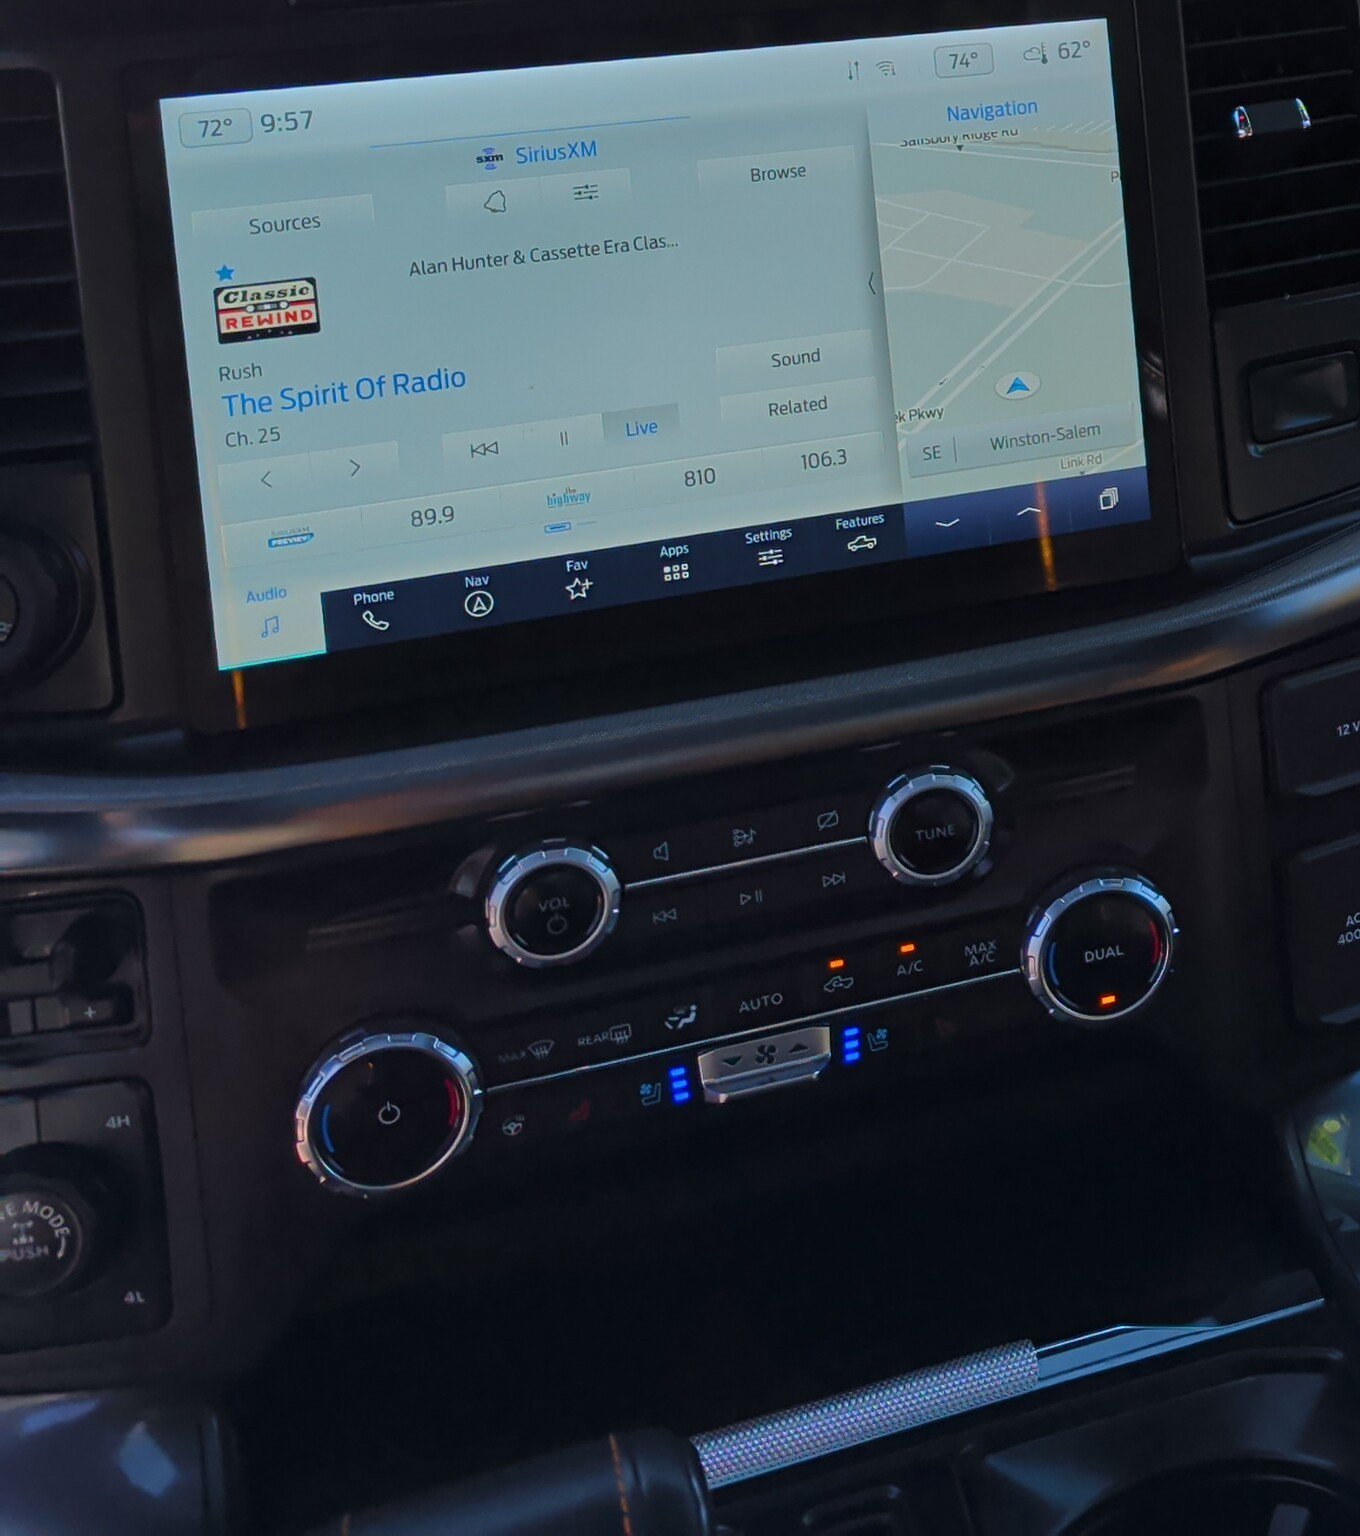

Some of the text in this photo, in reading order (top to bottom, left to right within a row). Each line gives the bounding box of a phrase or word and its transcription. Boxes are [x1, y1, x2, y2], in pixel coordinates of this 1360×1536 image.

[1058, 40, 1091, 60] 62°
[949, 51, 978, 69] 74°
[946, 100, 1039, 122] Navigation
[198, 118, 233, 138] 72°
[260, 110, 313, 133] 9:57
[475, 153, 504, 164] sxm
[515, 139, 598, 165] SiriusXM
[750, 164, 807, 183] Browse
[249, 215, 321, 235] Sources
[409, 235, 679, 276] Alan Hunter & Cassette Era Clas...
[223, 284, 310, 304] Classic
[225, 309, 314, 330] REWIND
[771, 348, 821, 368] Sound
[218, 362, 263, 382] Rush
[221, 367, 467, 417] The Spirit Of Radio
[768, 396, 828, 417] Related
[908, 406, 945, 422] Pkwy
[225, 426, 281, 448] Ch. 25
[626, 420, 658, 437] Live
[989, 423, 1101, 452] Winston-Salem
[800, 448, 848, 470] 106.3
[922, 445, 942, 461] SE
[1059, 453, 1103, 470] Link Rd
[684, 467, 717, 487] 810
[546, 491, 591, 509] highway
[410, 504, 455, 528] 89.9
[835, 513, 885, 531] Features
[745, 526, 793, 546] Settings
[659, 543, 690, 559] Apps
[566, 559, 589, 572] Fav
[464, 574, 490, 589] Nav
[246, 585, 288, 605] Audio
[353, 588, 395, 607] Phone
[1336, 723, 1350, 737] 12
[915, 825, 956, 842] TUNE
[538, 897, 570, 913] VOL
[964, 939, 998, 958] MAX
[1084, 945, 1125, 964] DUAL
[897, 959, 924, 976] A/C
[969, 951, 997, 968] A/C
[738, 992, 784, 1014] AUTO
[577, 1032, 610, 1047] REAR
[105, 1114, 131, 1130] 4H
[22, 1200, 71, 1238] MODE
[124, 1291, 146, 1304] 4L
